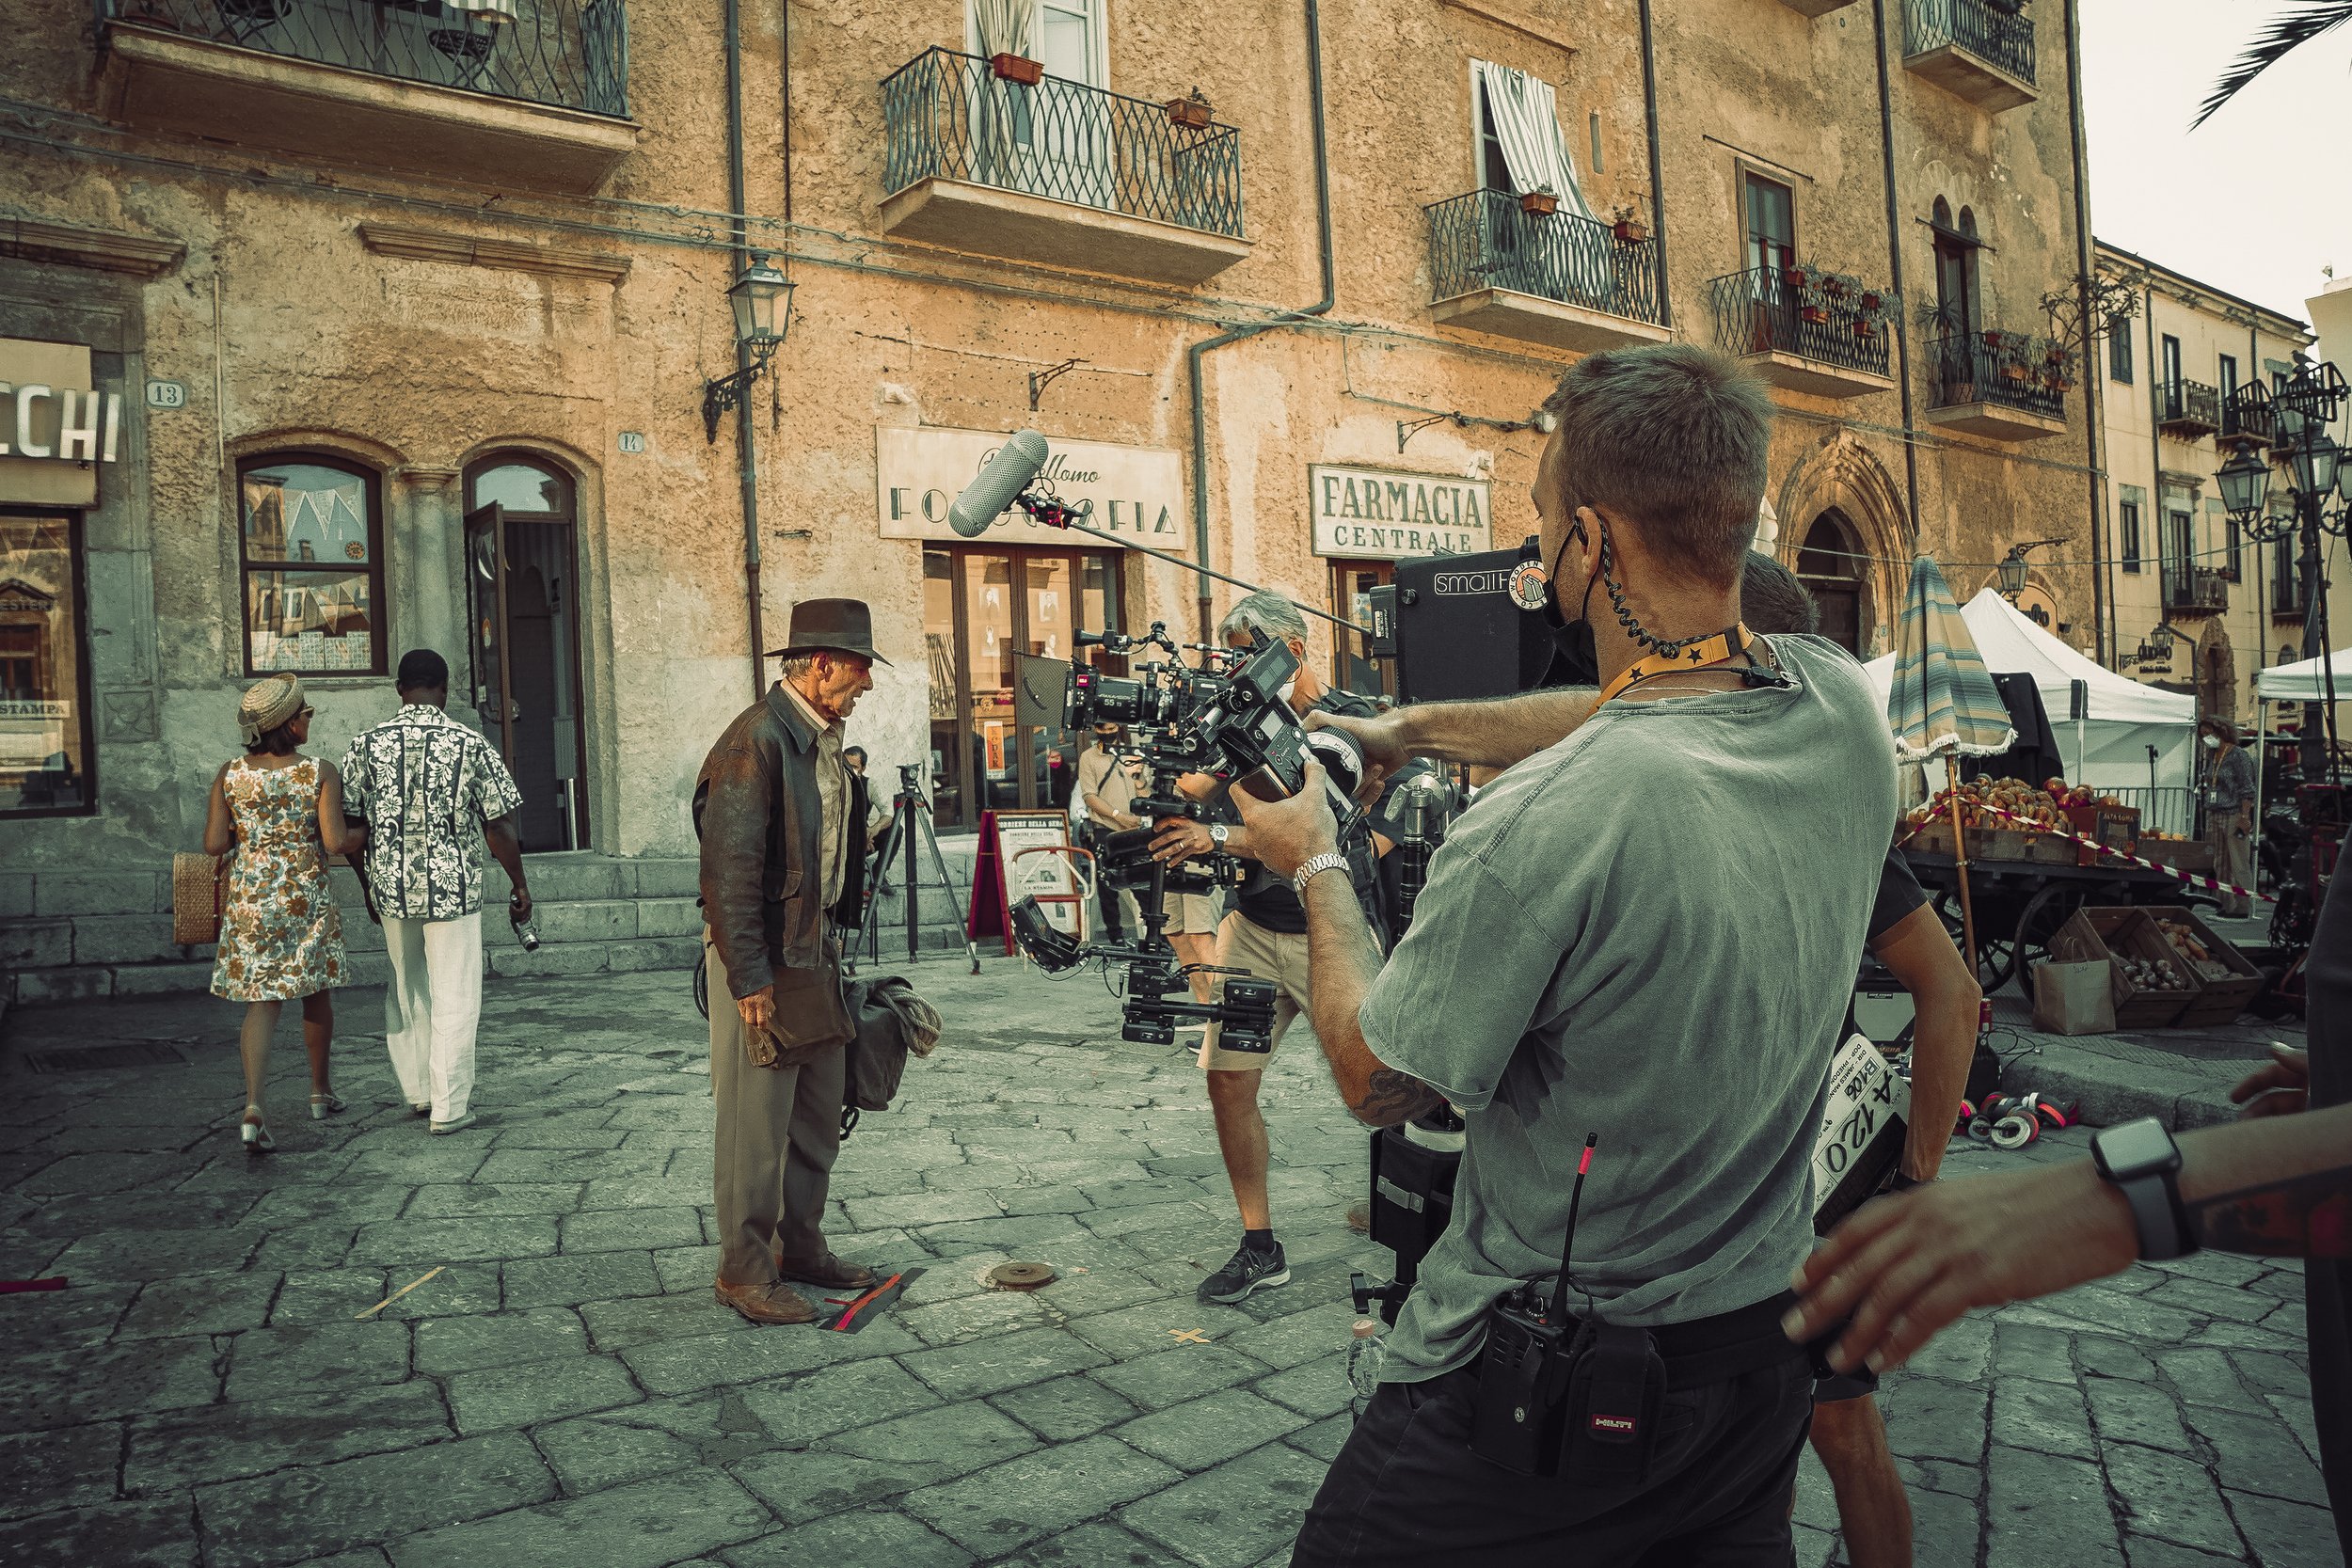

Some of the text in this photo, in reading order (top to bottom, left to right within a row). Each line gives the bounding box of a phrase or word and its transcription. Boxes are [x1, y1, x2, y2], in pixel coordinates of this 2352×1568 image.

[154, 385, 178, 404] 13
[0, 380, 120, 462] CHI
[890, 487, 1176, 534] FOAFIA
[1322, 476, 1484, 529] FARMACIA
[1334, 525, 1471, 553] CENTRALE
[1510, 561, 1539, 592] WOODEN
[1104, 698, 1115, 706] 55
[1830, 1042, 1862, 1085] DOP PHEDON
[1857, 1049, 1867, 1063] DIR
[1840, 1065, 1856, 1085] JAMES
[1596, 1418, 1632, 1429] HILTI
